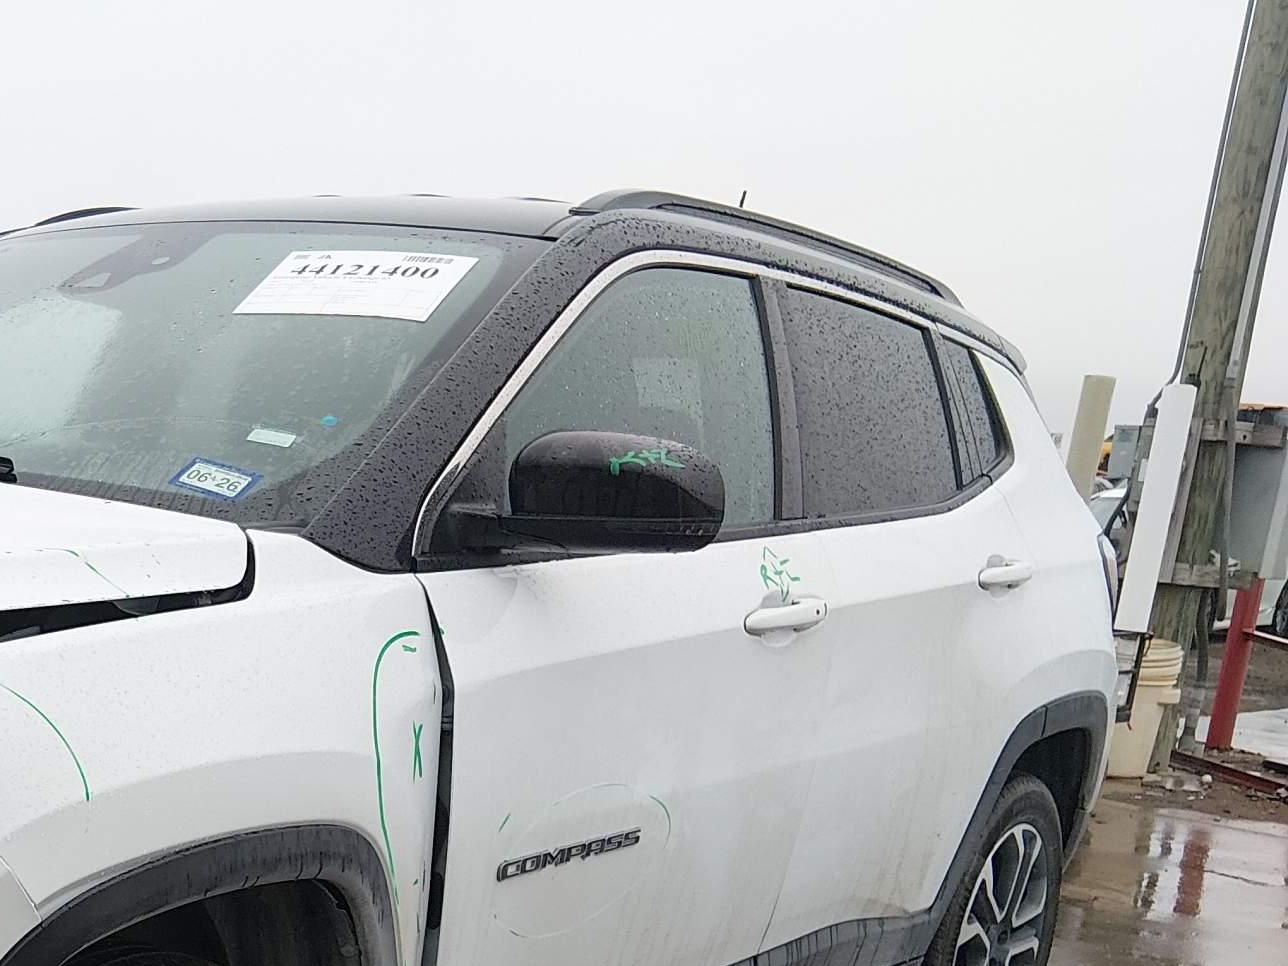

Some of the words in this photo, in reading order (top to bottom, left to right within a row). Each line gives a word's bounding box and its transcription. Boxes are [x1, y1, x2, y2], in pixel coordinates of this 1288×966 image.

[290, 263, 440, 279] 44121400
[186, 469, 211, 483] 06
[214, 477, 242, 492] 26
[496, 826, 642, 882] COMPASS
